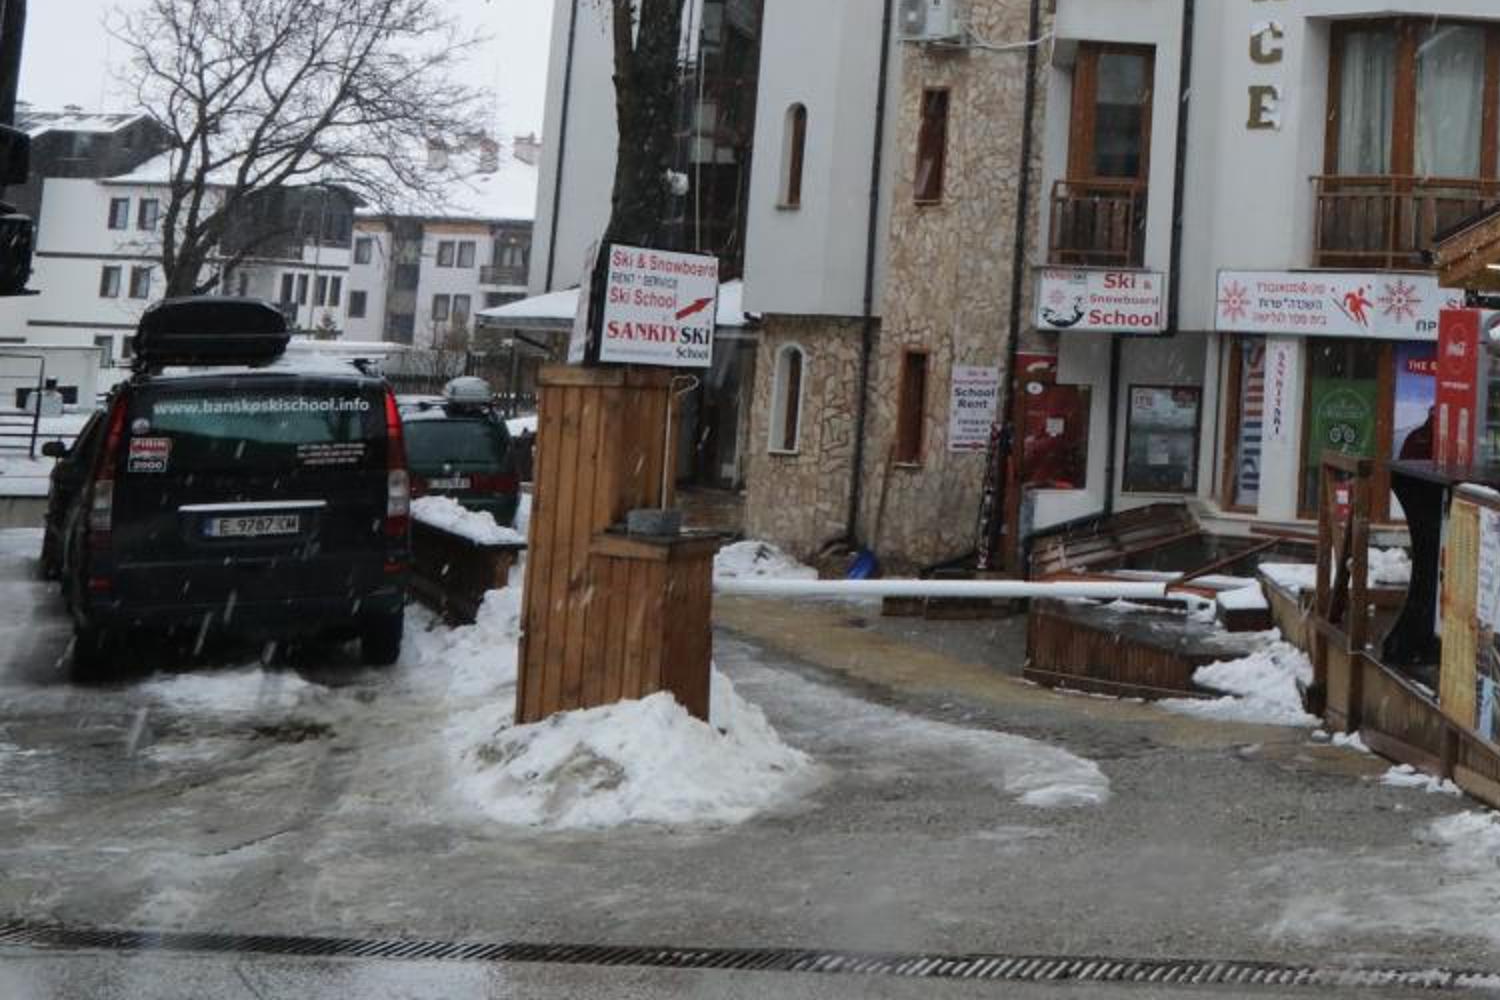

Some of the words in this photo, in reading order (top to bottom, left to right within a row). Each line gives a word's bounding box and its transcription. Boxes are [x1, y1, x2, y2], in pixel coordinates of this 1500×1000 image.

[612, 249, 633, 267] Ski
[649, 255, 717, 278] Snowboard
[1103, 272, 1136, 289] Ski
[610, 286, 631, 303] Ski
[633, 288, 678, 309] School
[1088, 309, 1159, 327] School
